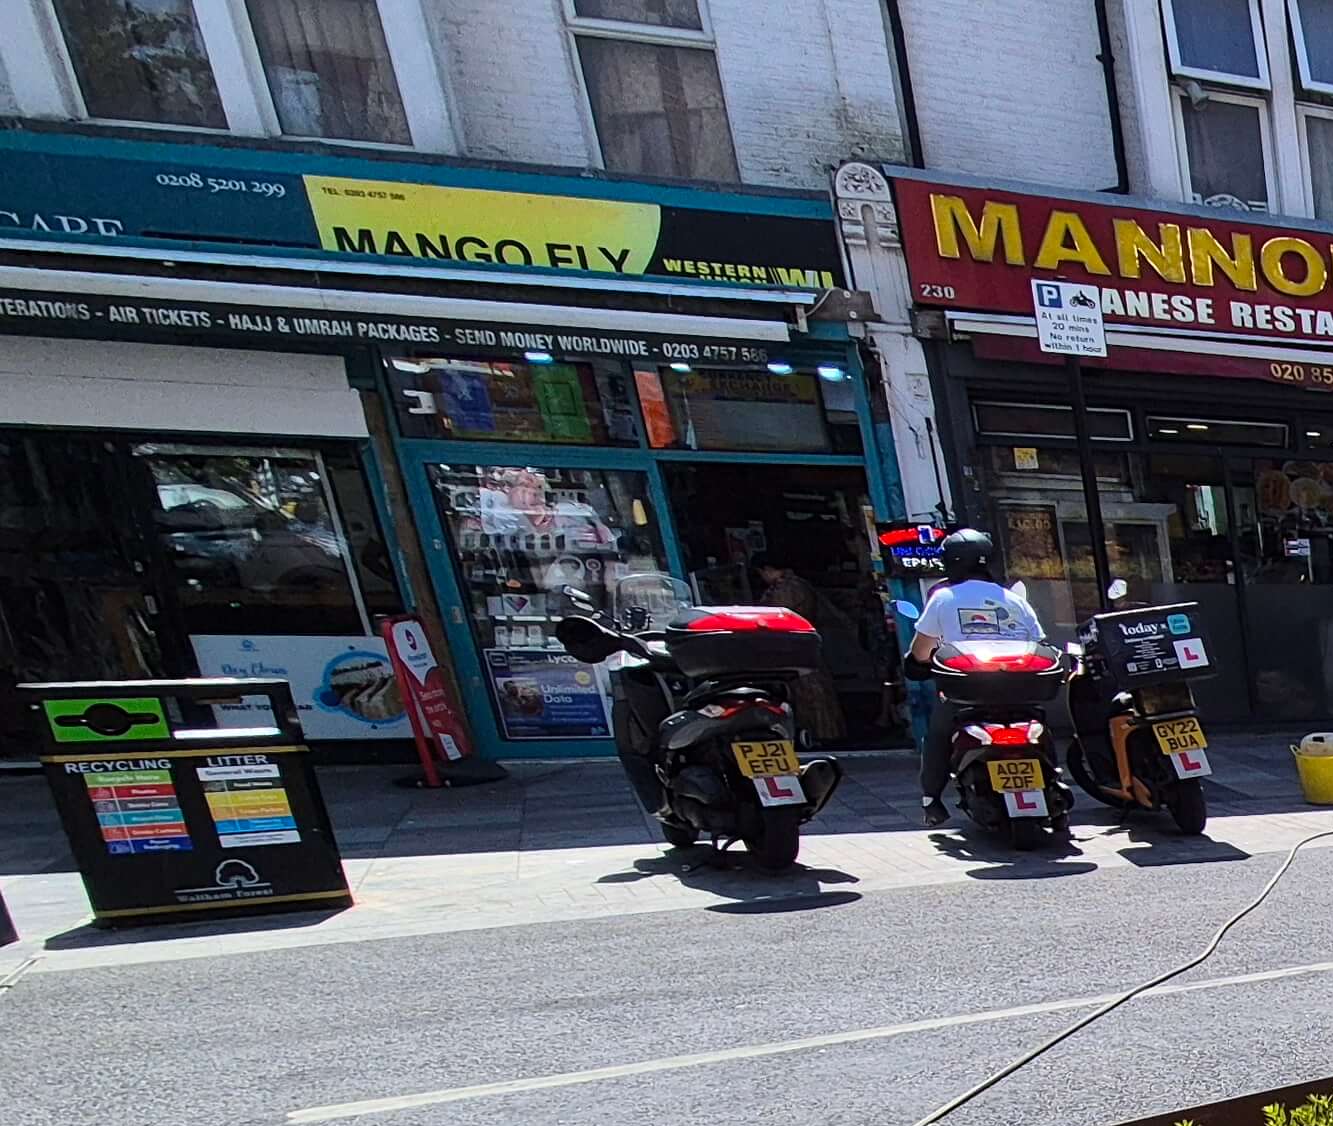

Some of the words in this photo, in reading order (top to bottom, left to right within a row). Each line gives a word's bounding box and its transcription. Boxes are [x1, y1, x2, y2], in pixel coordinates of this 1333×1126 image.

[155, 173, 204, 188] 0208
[208, 177, 247, 193] 5201
[251, 181, 286, 198] 299
[333, 226, 534, 265] MANGO
[663, 258, 768, 279] WESTERN
[920, 284, 955, 299] 230
[1041, 286, 1058, 305] P
[1042, 312, 1052, 320] At
[1073, 314, 1097, 324] times
[109, 306, 139, 324] AIR
[145, 308, 212, 329] TICKETS
[229, 314, 273, 332] HAJJ
[277, 316, 290, 334] &
[295, 318, 353, 338] UMRAH
[358, 322, 441, 344] PACKAGES
[456, 328, 495, 347] SEND
[500, 331, 554, 352] MONEY
[559, 335, 649, 357] WORLDWIDE
[663, 341, 699, 360] 0203
[703, 345, 737, 361] 4757
[742, 347, 769, 363] 586
[1052, 322, 1065, 330] 20
[1069, 325, 1090, 333] mins
[1050, 332, 1063, 341] No
[1066, 335, 1095, 343] return
[1271, 363, 1304, 381] 020
[1183, 647, 1199, 661] L
[541, 684, 597, 694] Unlimited
[543, 694, 573, 703] Data
[1157, 722, 1198, 738] GY22
[739, 743, 787, 758] PJ21
[1168, 736, 1199, 750] BUA
[65, 759, 172, 774] RECYCLING
[206, 754, 269, 767] LITTER
[749, 758, 790, 773] EFU
[1180, 753, 1201, 771] L
[763, 777, 793, 797] L
[1002, 776, 1033, 788] ZDF
[1014, 792, 1036, 810] L
